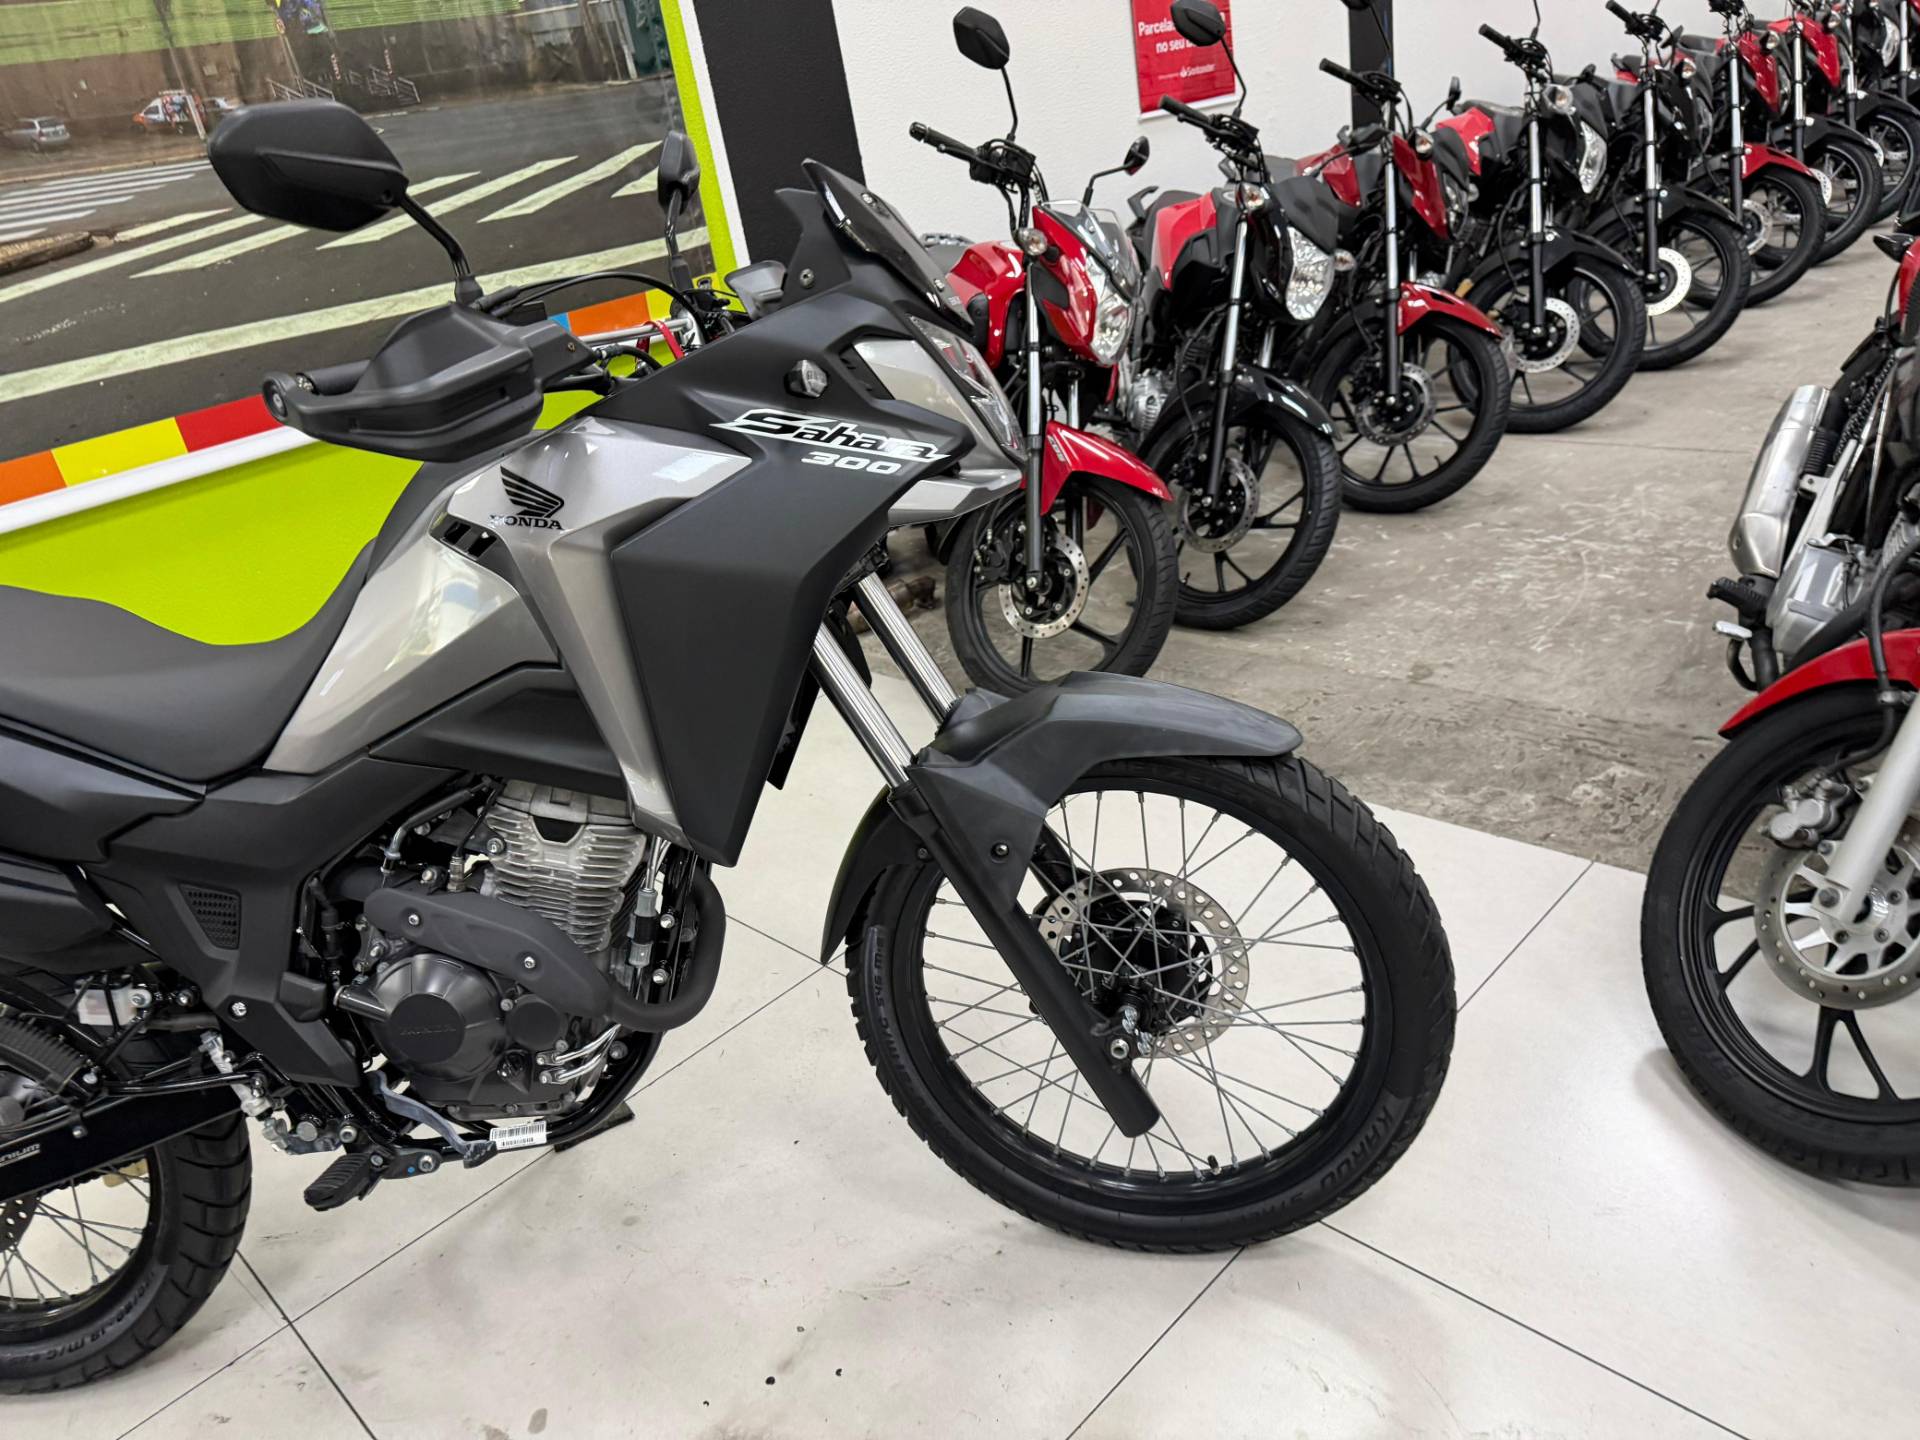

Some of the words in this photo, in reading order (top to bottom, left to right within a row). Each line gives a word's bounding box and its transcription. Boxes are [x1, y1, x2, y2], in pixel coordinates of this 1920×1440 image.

[1138, 17, 1175, 36] Parcela
[1156, 41, 1168, 54] no
[1169, 40, 1185, 51] seu
[801, 451, 901, 474] 300
